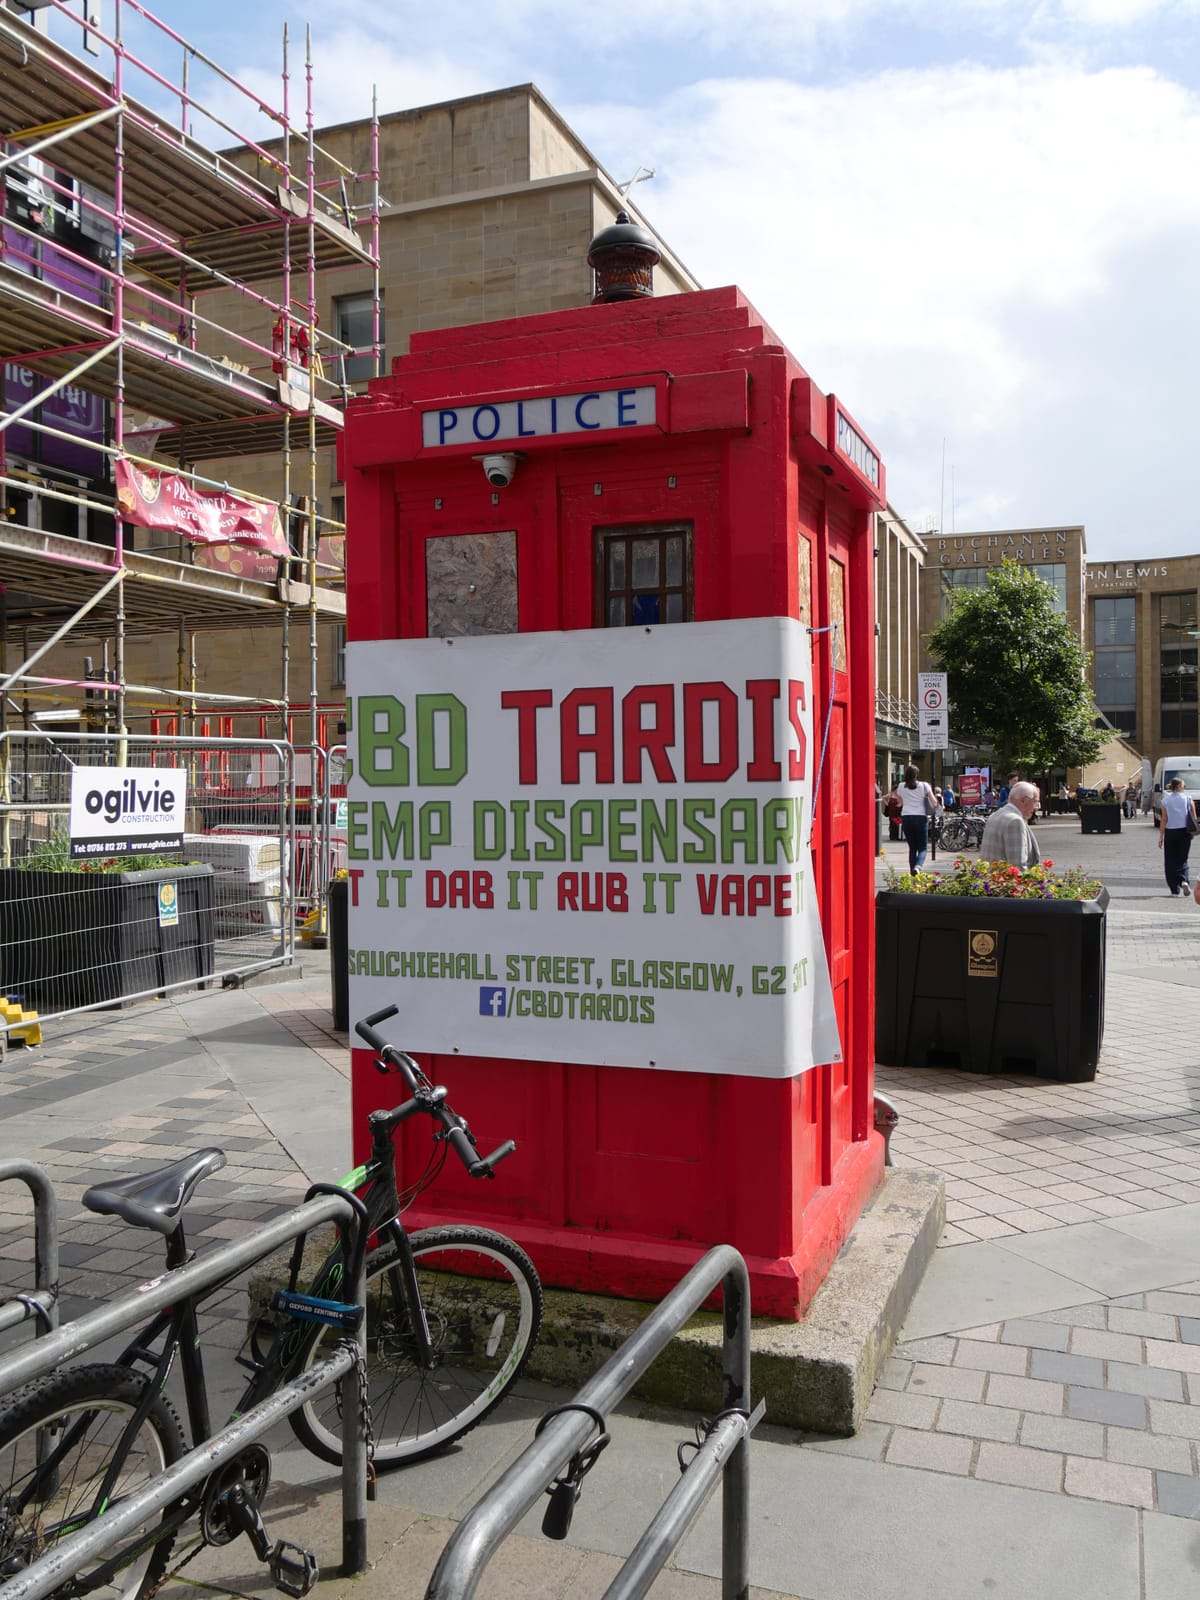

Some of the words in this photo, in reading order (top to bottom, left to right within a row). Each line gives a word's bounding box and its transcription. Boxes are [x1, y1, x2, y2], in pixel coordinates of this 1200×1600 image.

[439, 389, 637, 445] POLICE
[938, 532, 1067, 550] BUCHANAN
[939, 547, 1066, 564] GALLERIES
[1116, 567, 1168, 579] LEWIS
[347, 693, 468, 787] BD
[501, 679, 806, 785] TARDIS
[85, 779, 175, 824] ogilvie
[122, 814, 175, 823] CONSTRUCTION
[473, 797, 804, 864] DISPENSARY
[376, 870, 413, 908] IT
[426, 870, 494, 909] DAB
[507, 871, 544, 910] IT
[557, 872, 629, 912] RUB
[643, 873, 682, 914] IT
[696, 874, 793, 917] VAPE
[348, 948, 498, 980] SAUCHIEHALL
[506, 955, 603, 989] STREET,
[611, 958, 743, 997] GLASGOW,
[752, 965, 787, 995] G2
[289, 1302, 313, 1313] OXFORD
